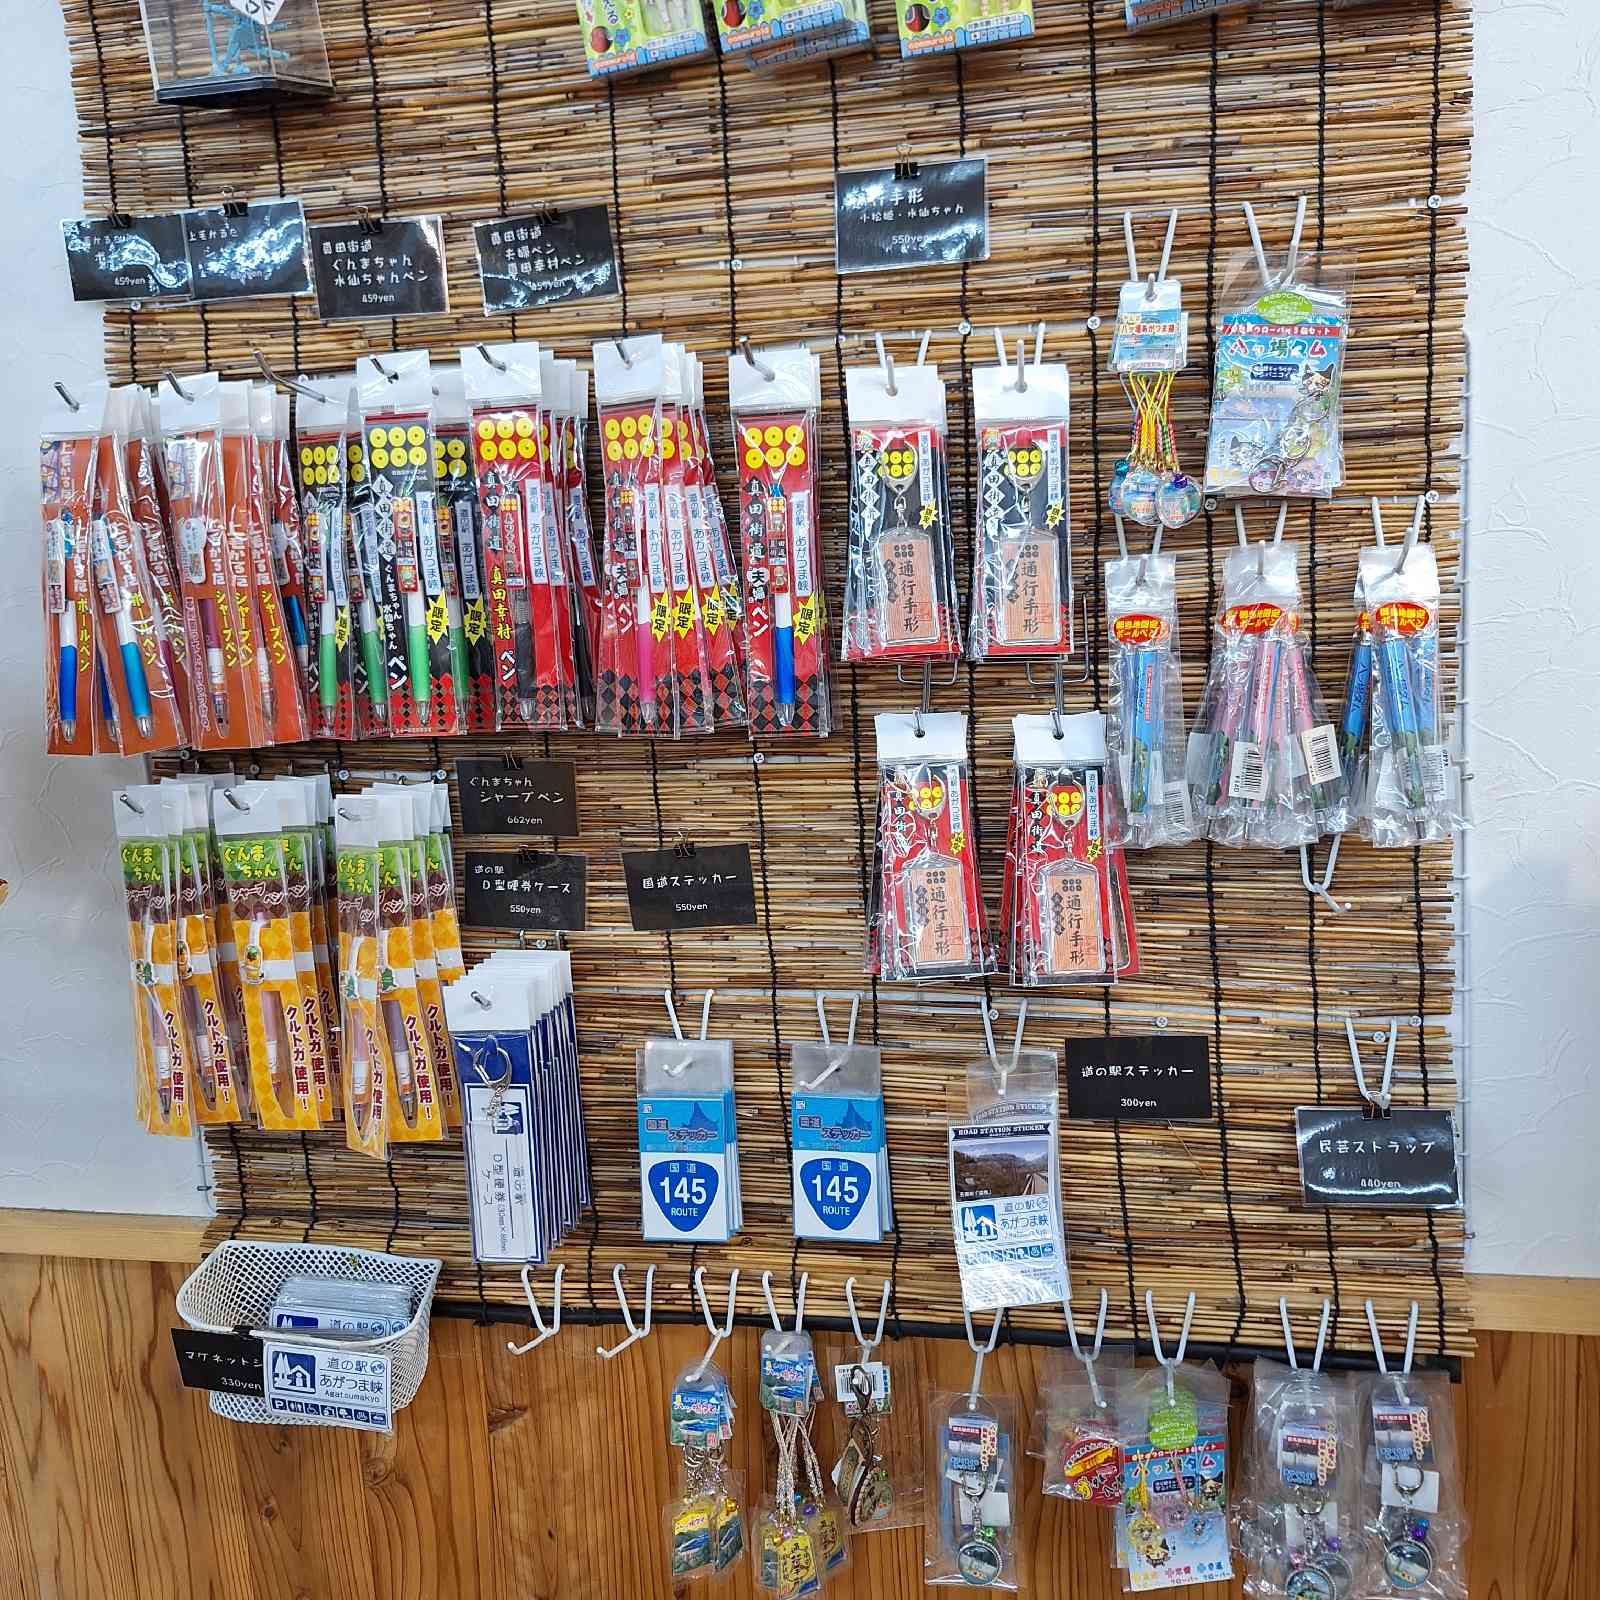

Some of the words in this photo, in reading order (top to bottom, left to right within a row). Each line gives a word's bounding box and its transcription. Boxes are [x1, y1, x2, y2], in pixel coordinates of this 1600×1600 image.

[860, 204, 964, 223] 小松姫・水仙ちゃん
[505, 243, 556, 260] 夫婦ペン
[332, 255, 413, 271] ぐんまちゃん
[334, 270, 429, 288] 水仙ちゃんペン
[362, 294, 395, 304] 459yen
[384, 565, 403, 620] ぐんまちゃん
[898, 560, 919, 633] 通行手形
[1021, 561, 1040, 634] 通行手形
[490, 565, 513, 641] 真田幸村
[430, 606, 445, 633] 限定
[617, 603, 633, 634] ペン
[655, 604, 667, 632] 限定
[676, 602, 692, 630] 限定
[706, 600, 720, 626] 限定
[751, 605, 769, 638] ペン
[798, 607, 814, 636] 限定
[215, 591, 238, 668] シャープペン
[261, 591, 287, 666] シャープペン
[383, 604, 399, 651] 水仙ちゃん
[467, 609, 483, 636] 限定
[387, 655, 408, 691] ペン
[500, 650, 516, 681] ペン
[470, 776, 534, 788] ぐんまちゃん
[480, 791, 565, 804] シャープペン
[507, 816, 543, 826] 662yen
[122, 847, 153, 864] ぐんま
[223, 844, 265, 864] ぐんま
[133, 867, 161, 881] ちゃん
[238, 863, 277, 878] ちゃん
[474, 865, 505, 875] 道の駅
[482, 879, 571, 895] D型硬券ケース
[642, 872, 737, 889] 国道ステッカー
[510, 904, 542, 915] 550yen
[675, 903, 708, 911] 550yen
[930, 886, 951, 956] 通行手形
[1066, 894, 1085, 964] 通行手形
[1081, 1065, 1195, 1078] 道の駅ステッカー
[1120, 1098, 1157, 1108] 300yen
[668, 1127, 718, 1142] ステッカー
[822, 1127, 872, 1140] ステッカー
[958, 1128, 978, 1136] ROAD
[980, 1125, 1012, 1134] STATION
[1013, 1123, 1046, 1132] STICKER
[1319, 1139, 1436, 1154] 民芸ストラップ
[660, 1176, 708, 1205] 145
[811, 1174, 860, 1204] 145
[1361, 1179, 1401, 1189] 440yen
[671, 1207, 699, 1217] ROUTE
[823, 1205, 851, 1216] ROUTE
[1001, 1214, 1050, 1230] あがつま峡
[327, 1356, 369, 1373] 道の駅
[221, 1377, 262, 1390] 330yen
[319, 1373, 384, 1395] あがつま峡
[325, 1390, 381, 1403] Agatsumakyo
